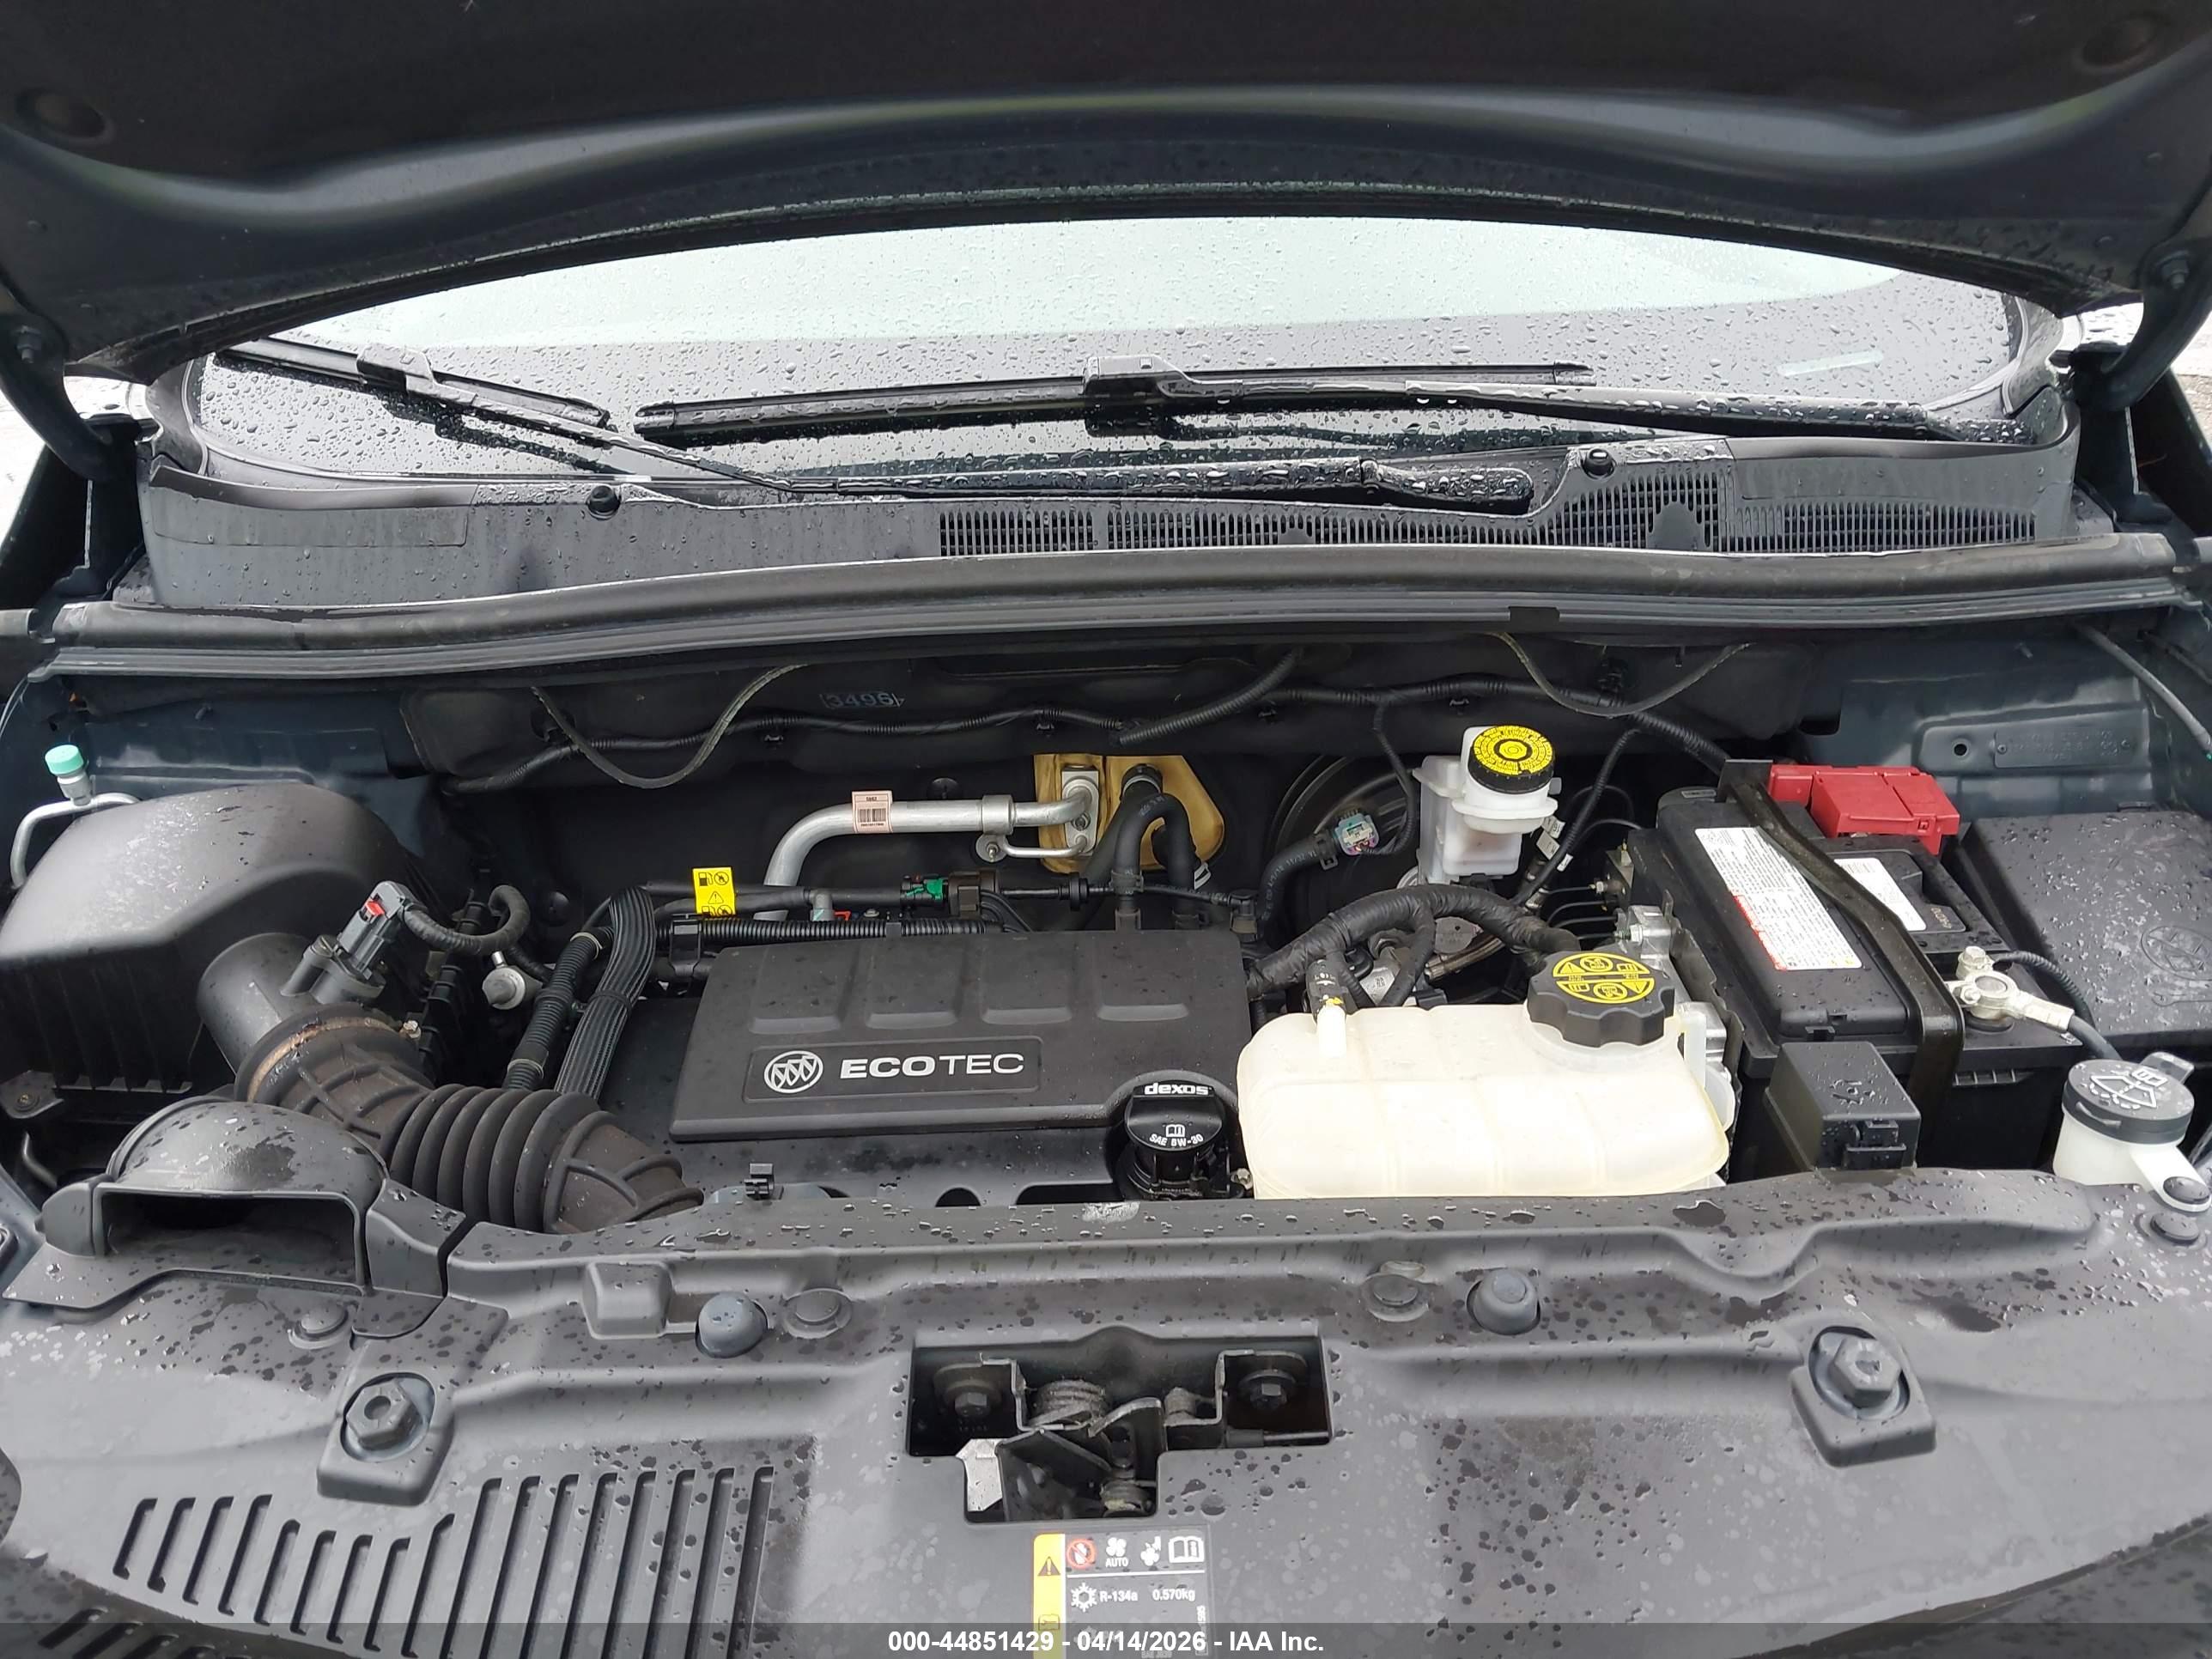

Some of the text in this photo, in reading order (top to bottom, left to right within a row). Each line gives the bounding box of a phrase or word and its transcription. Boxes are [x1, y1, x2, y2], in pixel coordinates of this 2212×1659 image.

[840, 1053, 1024, 1079] ECOTEC
[1144, 1082, 1209, 1096] dexos
[1149, 1133, 1204, 1146] SAE 5W-30
[1105, 1558, 1129, 1568] AUTO
[1099, 1589, 1196, 1602] R-134a 0.570kg
